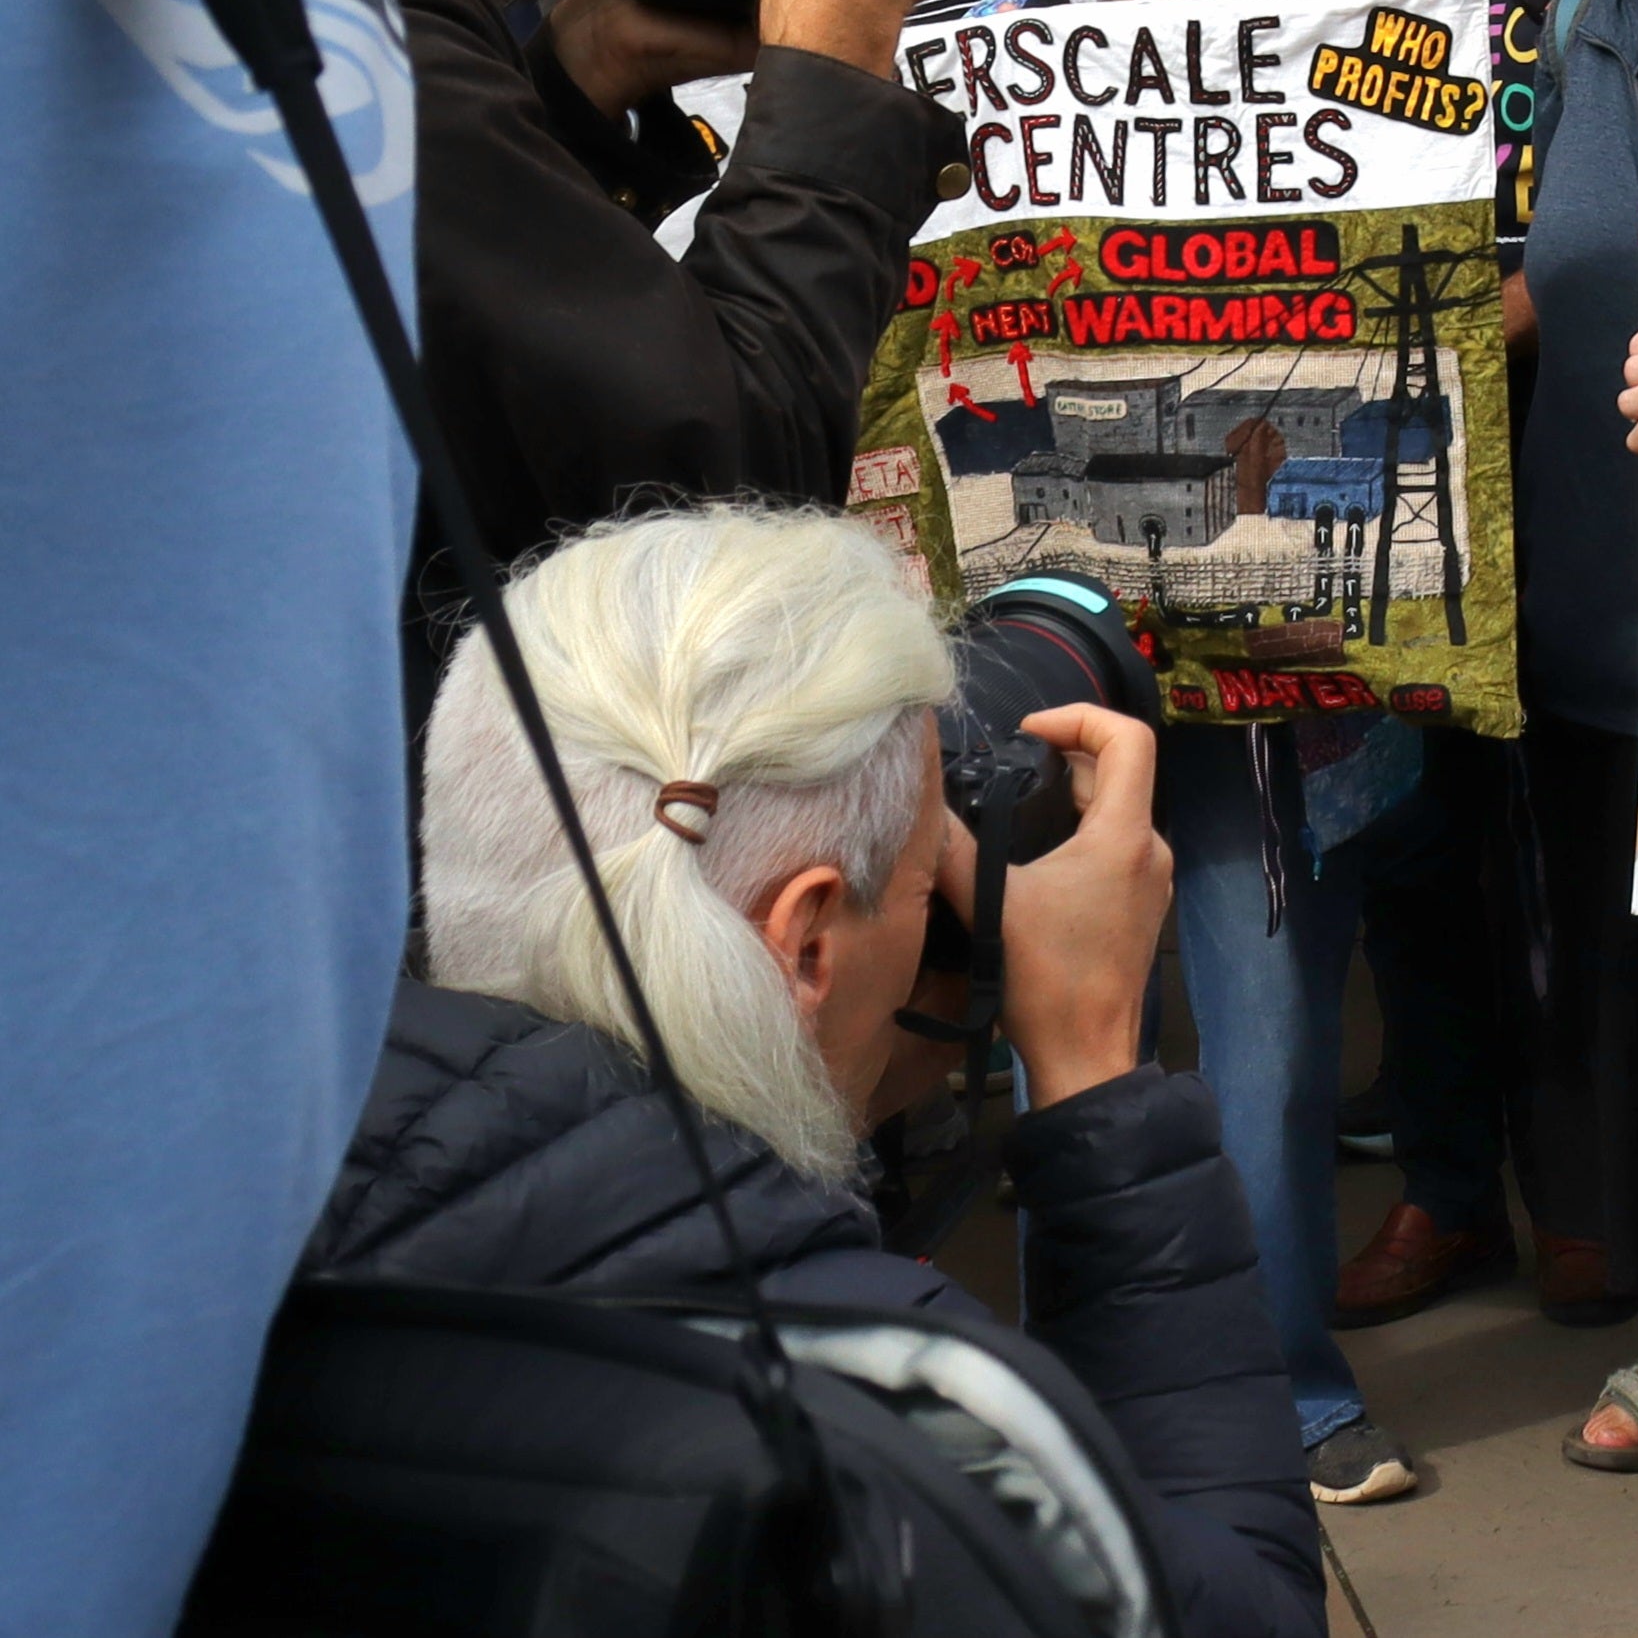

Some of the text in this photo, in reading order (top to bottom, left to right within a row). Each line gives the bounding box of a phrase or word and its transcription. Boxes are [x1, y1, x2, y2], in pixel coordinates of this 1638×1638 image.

[1371, 11, 1446, 70] WHO
[1312, 48, 1485, 131] PROFITS?
[970, 108, 1358, 212] CENTRES
[1101, 228, 1336, 281] GLOBAL
[974, 293, 1353, 347] HEAT WARMING
[849, 459, 916, 495] ETA
[1213, 668, 1378, 712] WATER
[1391, 688, 1446, 712] use
